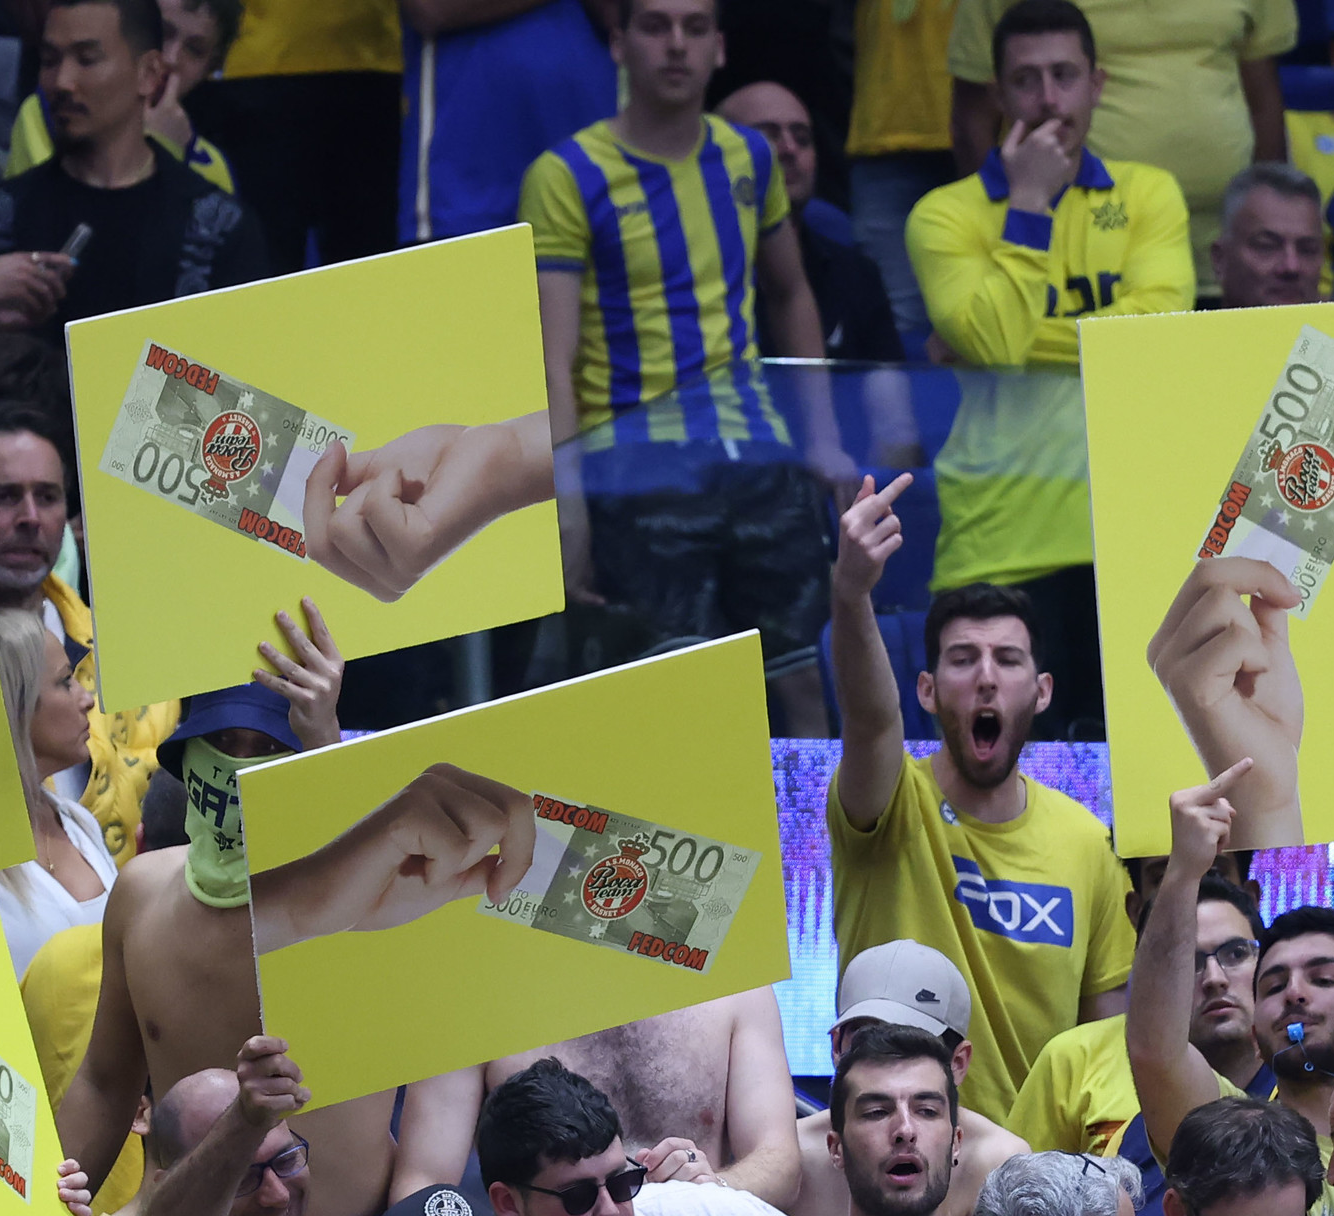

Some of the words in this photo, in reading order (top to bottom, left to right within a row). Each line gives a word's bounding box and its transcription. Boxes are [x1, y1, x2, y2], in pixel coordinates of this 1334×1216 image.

[145, 344, 220, 395] FEDCOM
[1259, 362, 1324, 446] 500
[133, 441, 208, 505] 500
[642, 830, 725, 884] 500
[732, 852, 748, 864] 500
[590, 902, 619, 918] BASKET
[627, 931, 710, 972] FEDCOM
